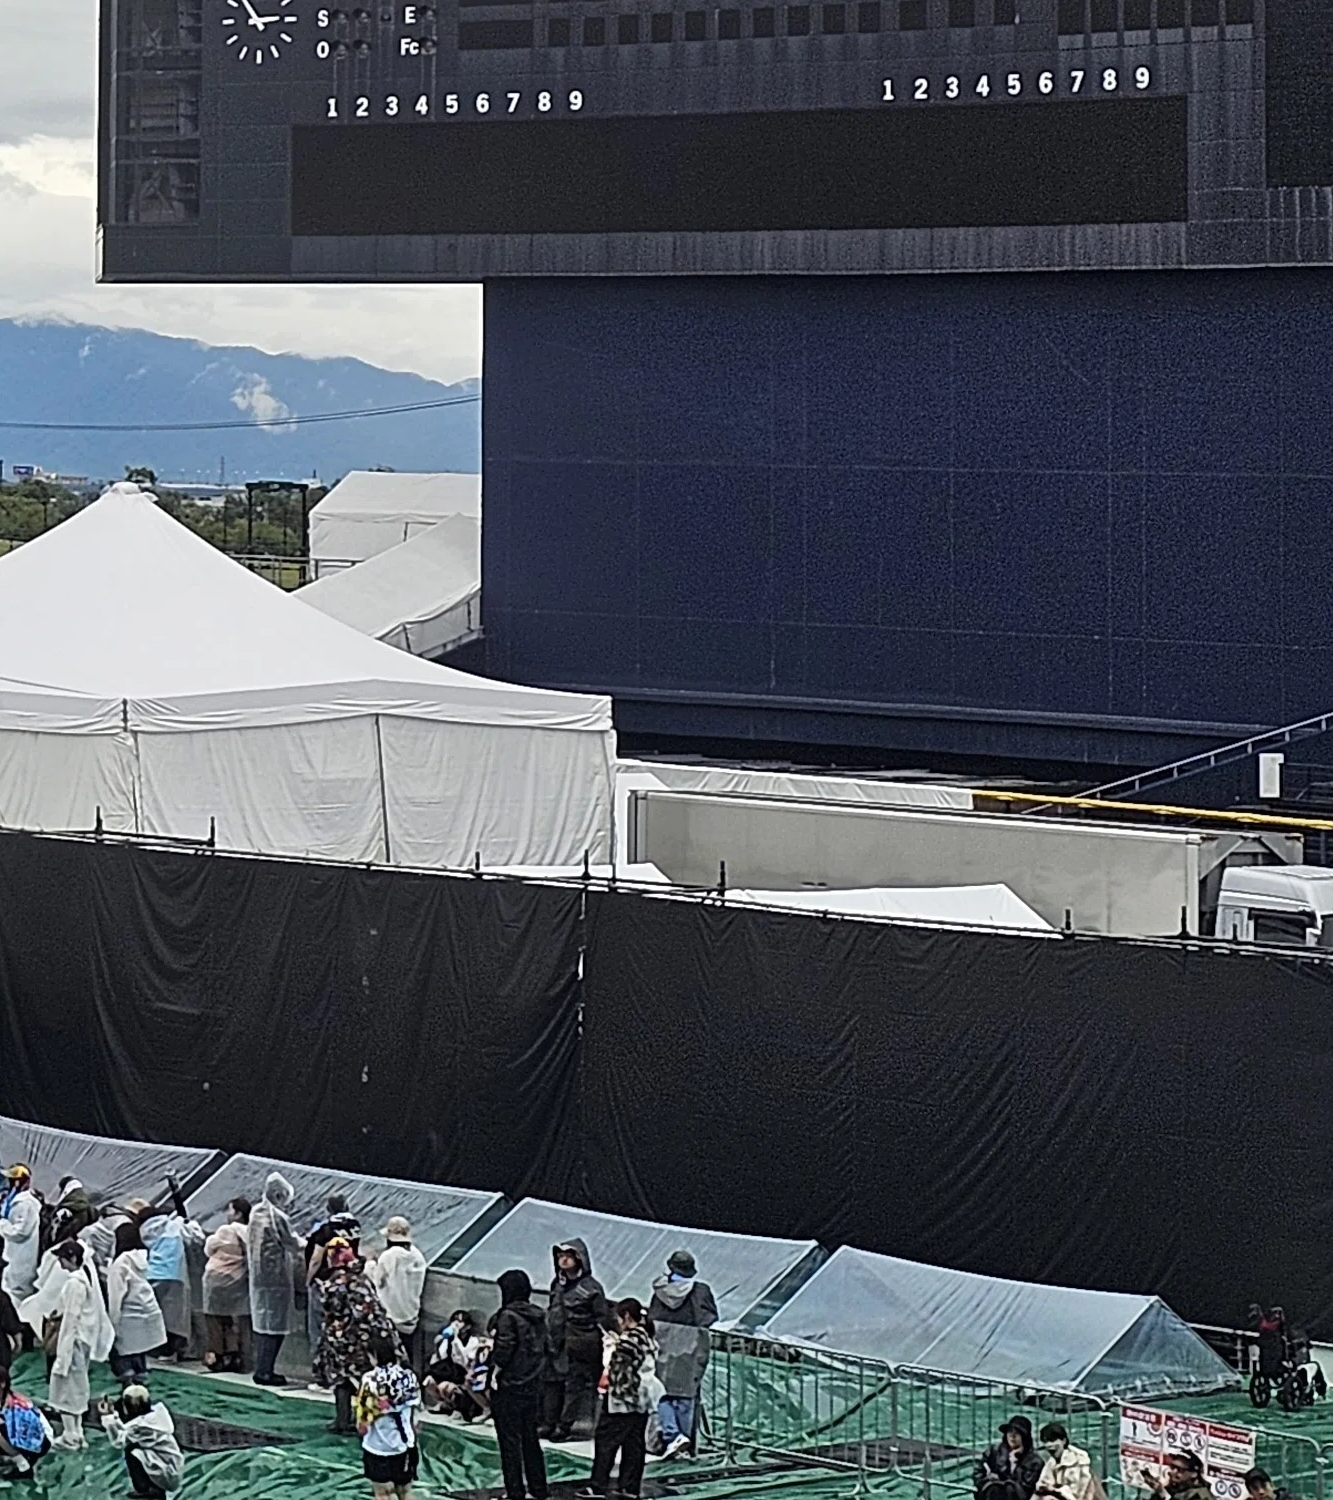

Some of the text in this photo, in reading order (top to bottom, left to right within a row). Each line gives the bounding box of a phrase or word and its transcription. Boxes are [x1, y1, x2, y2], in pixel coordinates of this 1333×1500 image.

[317, 9, 329, 28] S
[405, 6, 416, 24] E
[400, 38, 419, 56] Fc
[882, 67, 1150, 101] 1 2 3 4 5 6 7 8 9
[327, 90, 583, 117] 1 2 3 4 5 6 7 8 9
